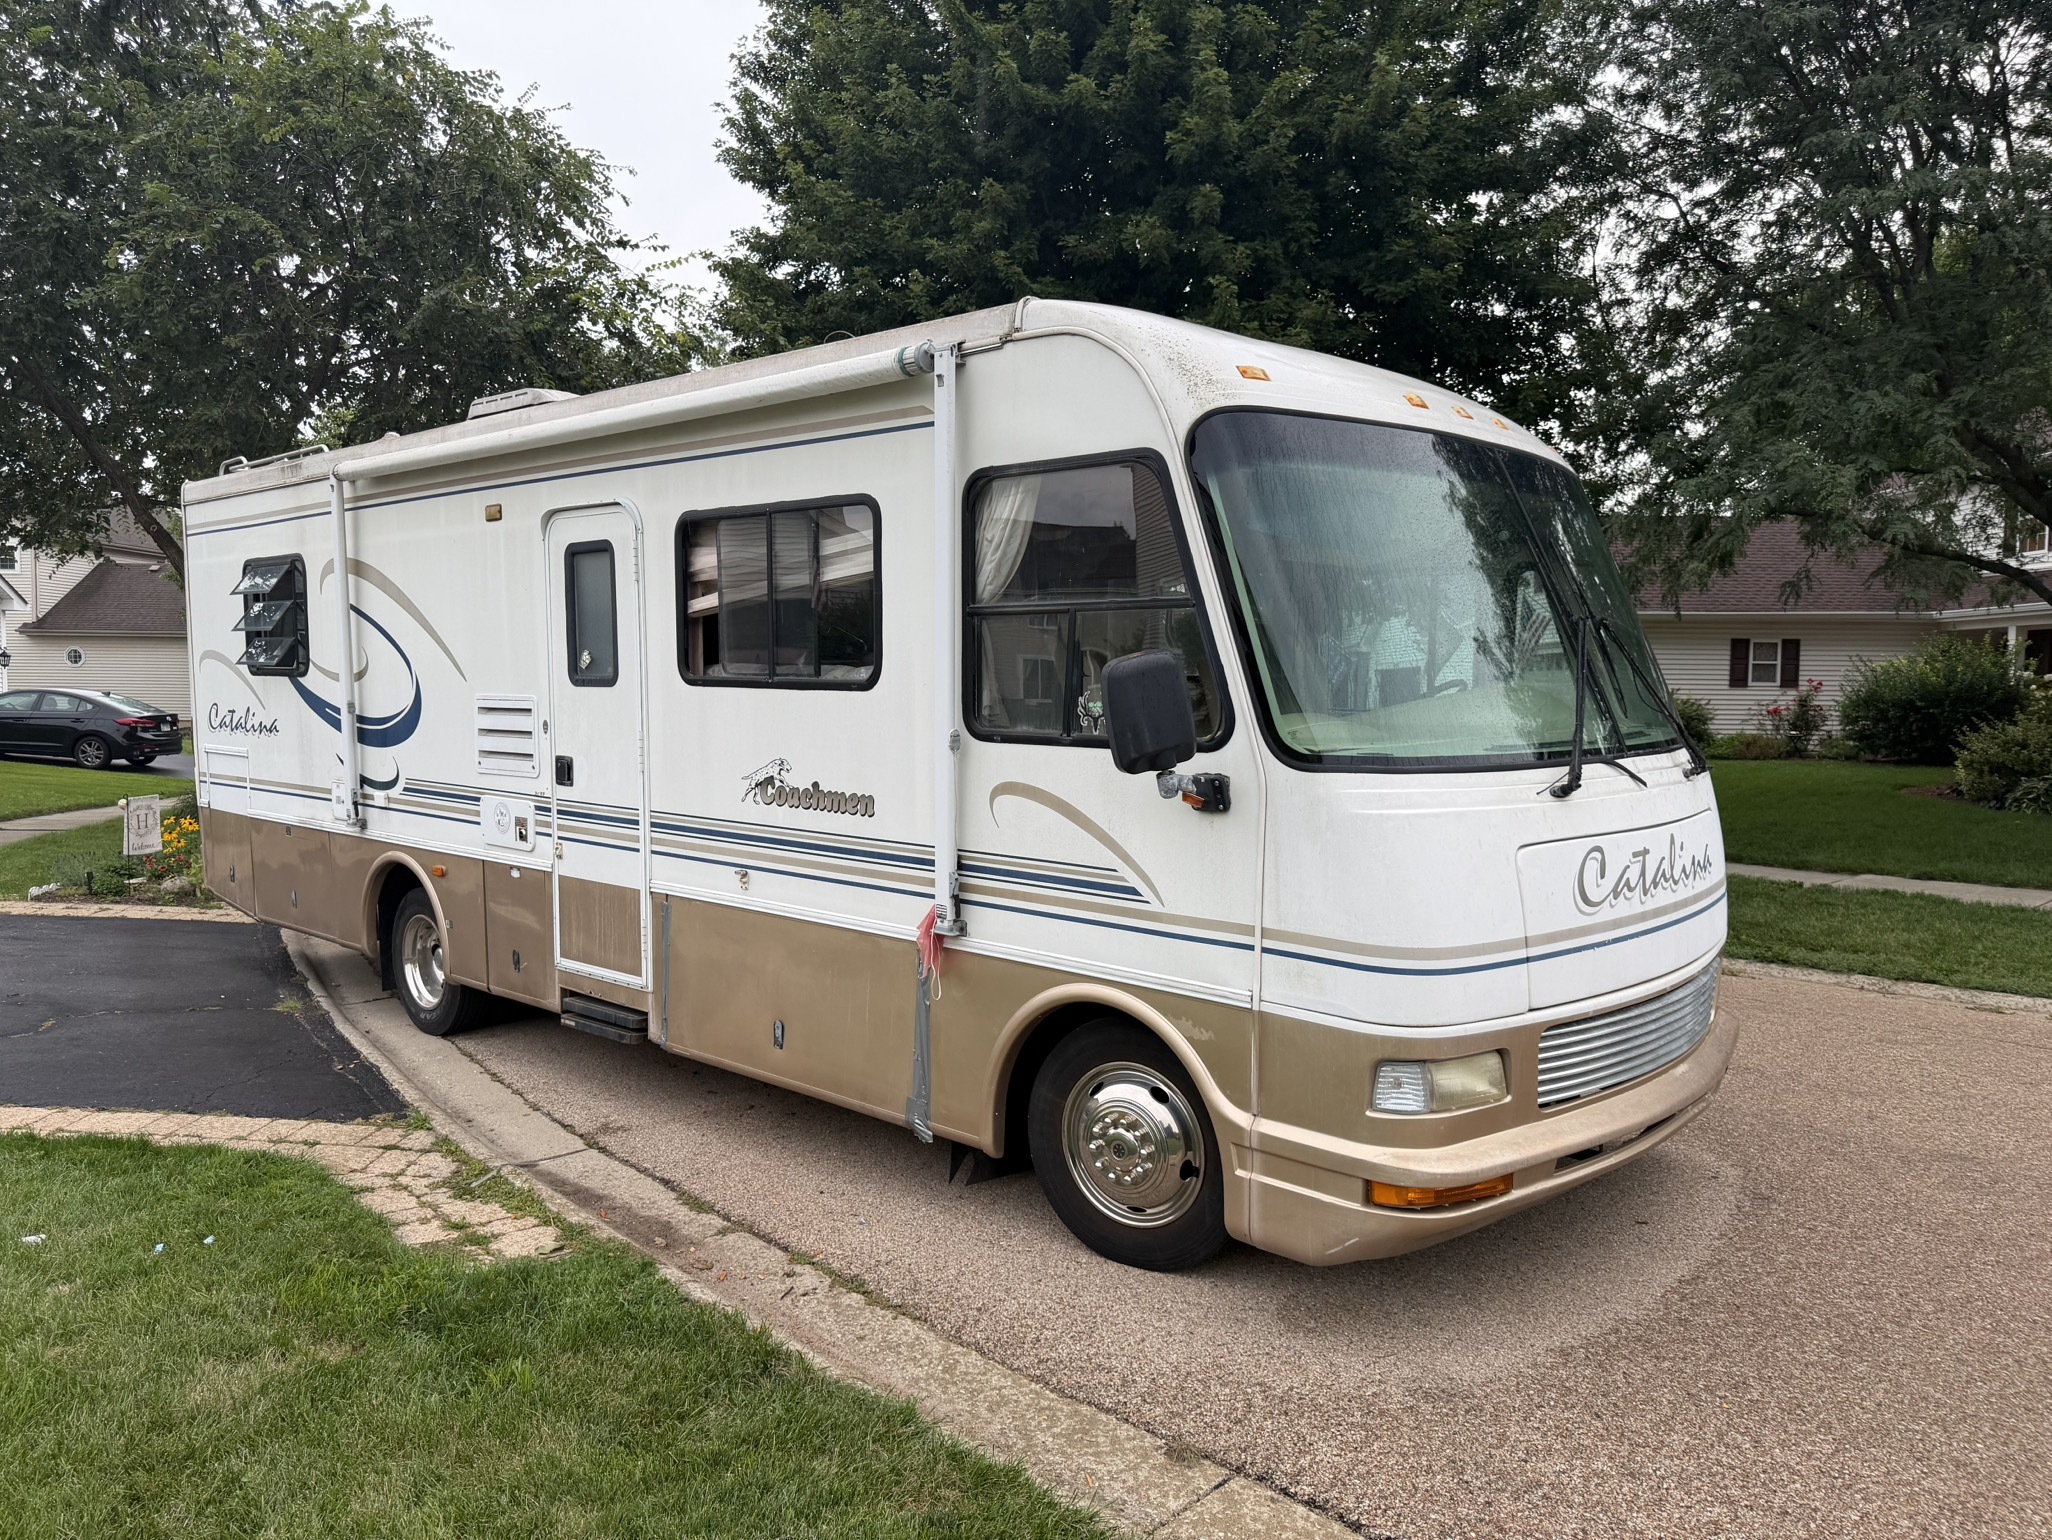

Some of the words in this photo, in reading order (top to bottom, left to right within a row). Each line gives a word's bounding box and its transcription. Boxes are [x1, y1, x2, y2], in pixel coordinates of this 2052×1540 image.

[208, 703, 279, 737] Catalina
[760, 775, 875, 817] Coachmen
[135, 812, 149, 830] H
[1574, 833, 1712, 914] Catalina
